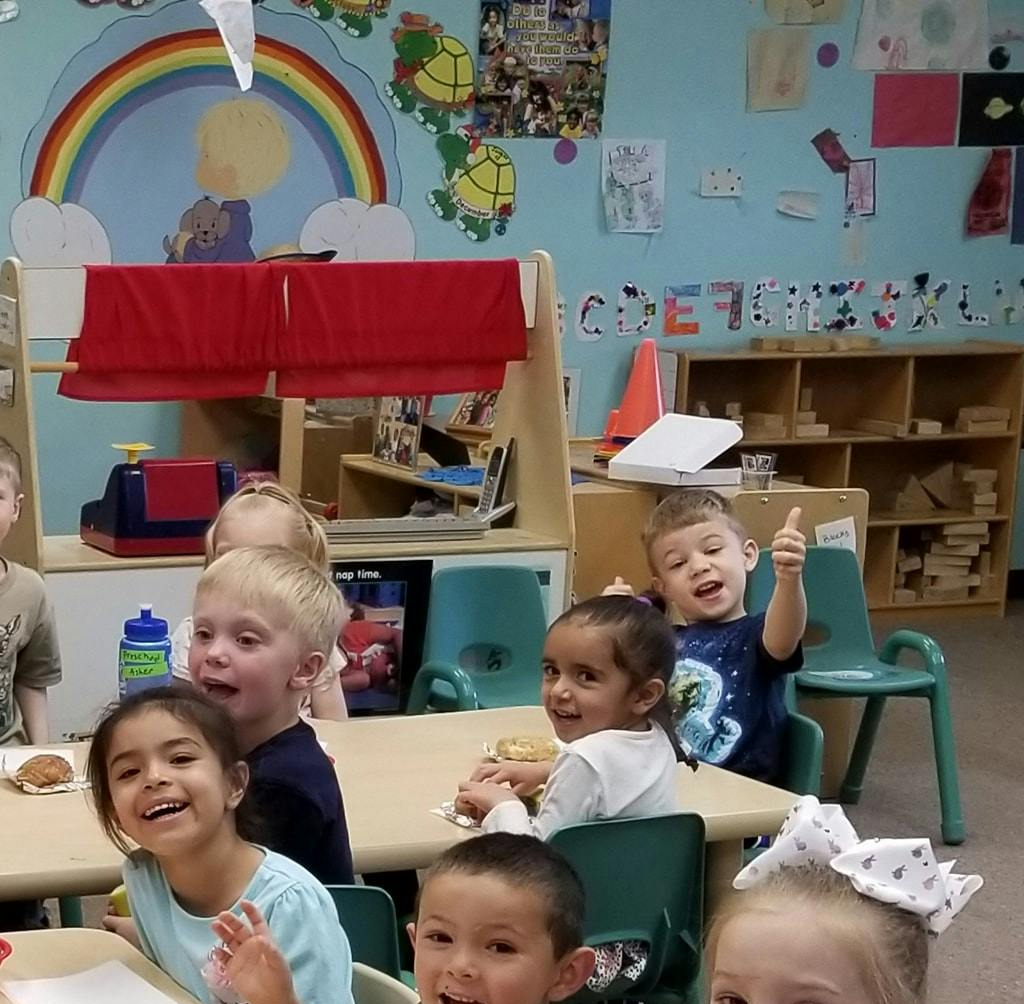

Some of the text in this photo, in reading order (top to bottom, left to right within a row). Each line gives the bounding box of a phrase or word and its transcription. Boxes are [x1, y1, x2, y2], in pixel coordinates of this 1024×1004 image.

[506, 19, 547, 30] others
[517, 31, 576, 43] you would
[535, 44, 561, 55] them
[455, 197, 491, 218] December
[336, 571, 355, 581] nap
[357, 569, 382, 579] time.
